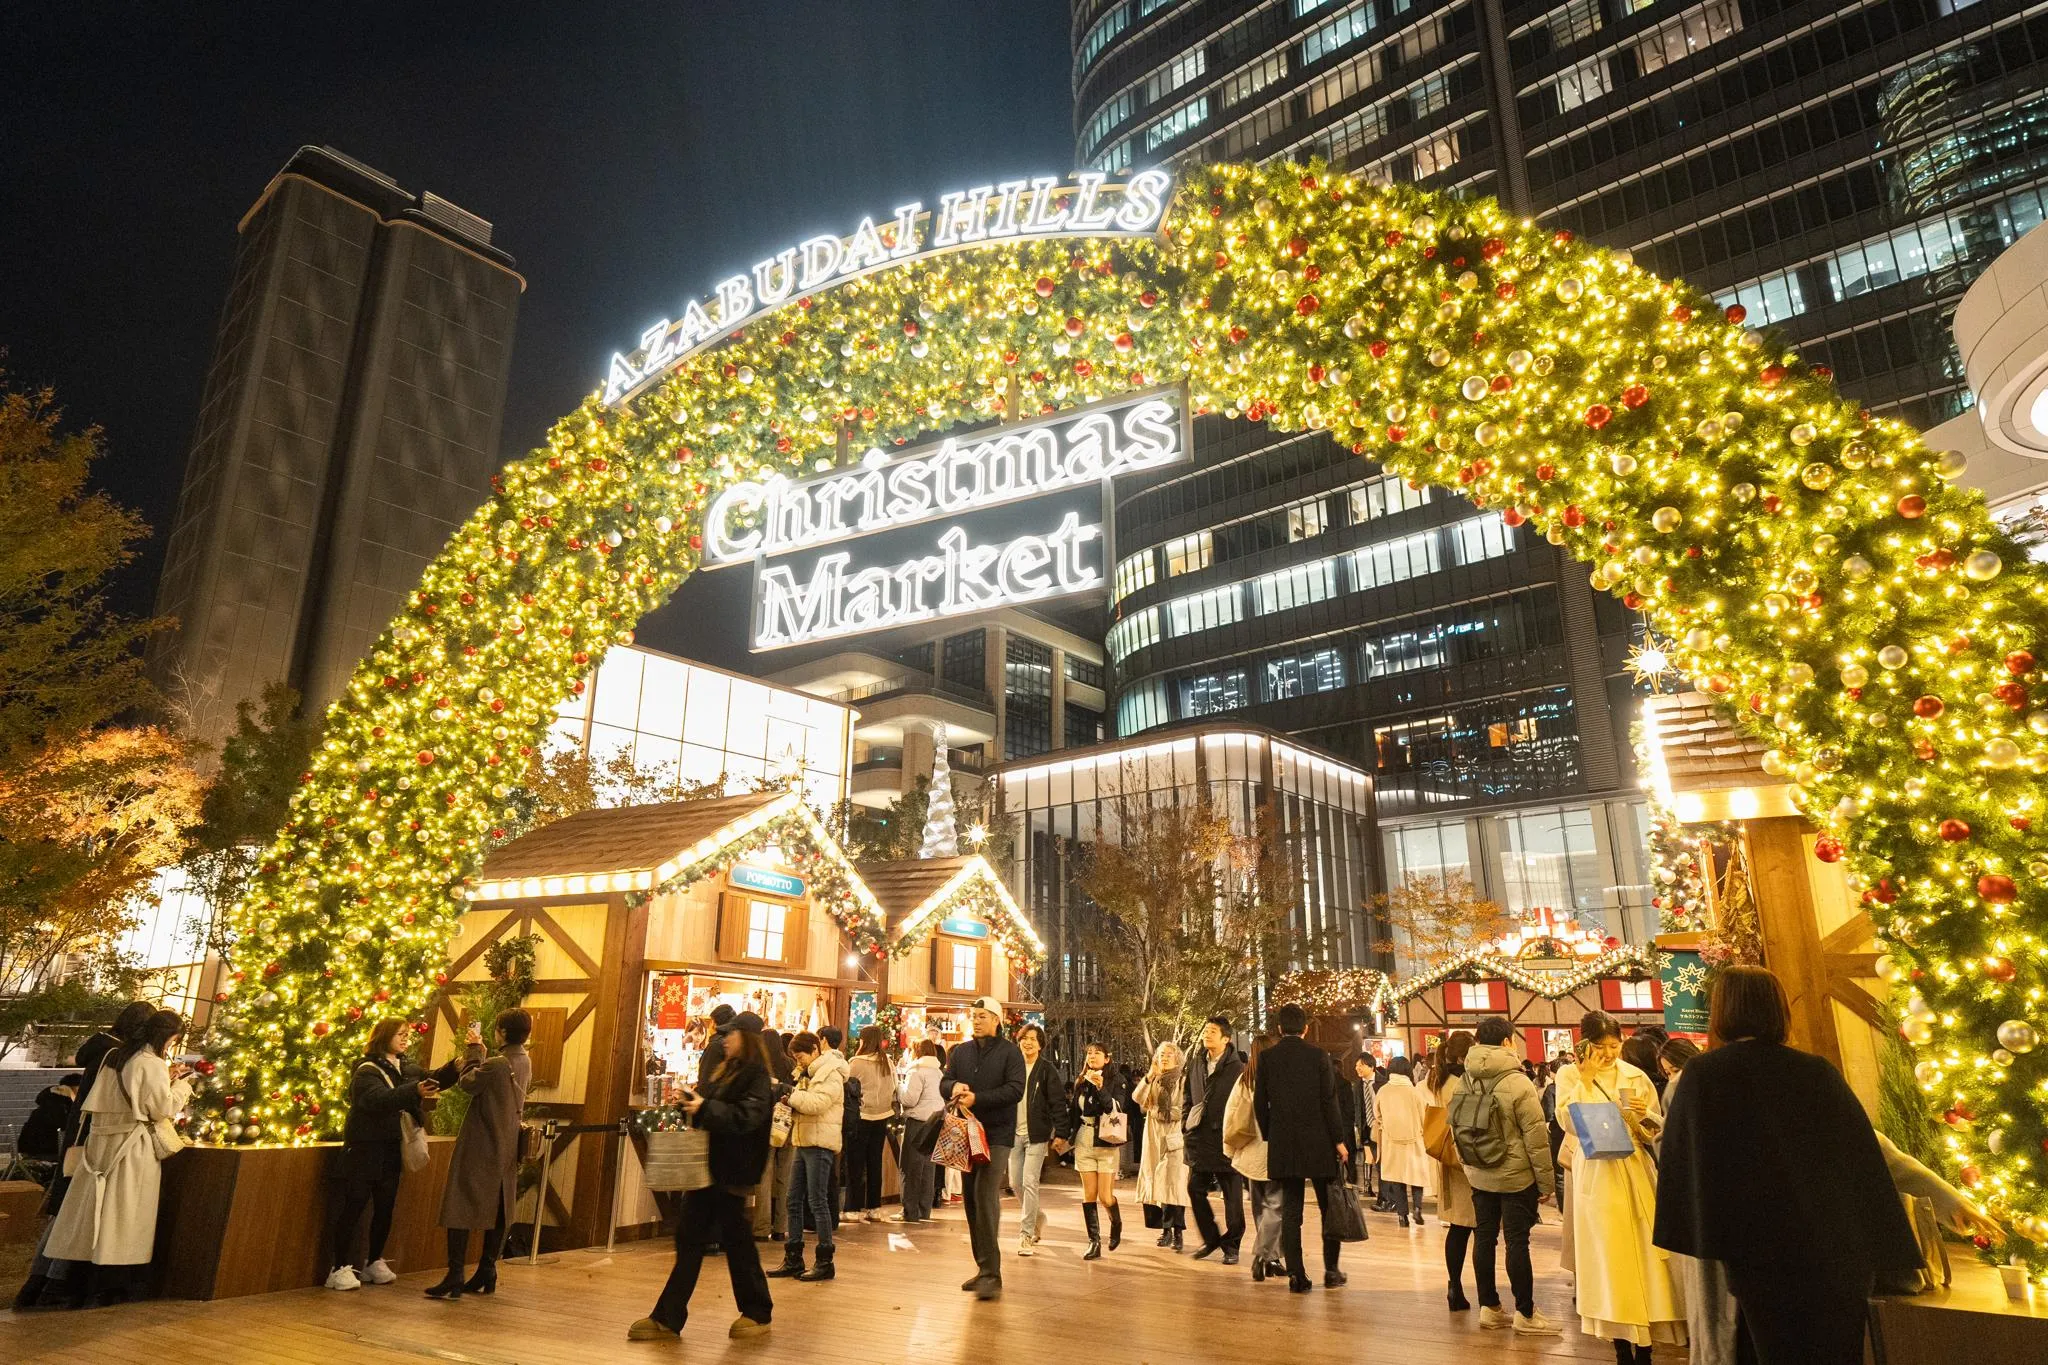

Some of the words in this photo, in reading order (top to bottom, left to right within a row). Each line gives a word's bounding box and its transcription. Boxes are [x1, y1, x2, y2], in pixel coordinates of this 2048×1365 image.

[601, 200, 922, 402] AZABUDAI
[933, 169, 1171, 248] HILLS
[705, 398, 1178, 564] Christmas
[756, 509, 1098, 648] Market
